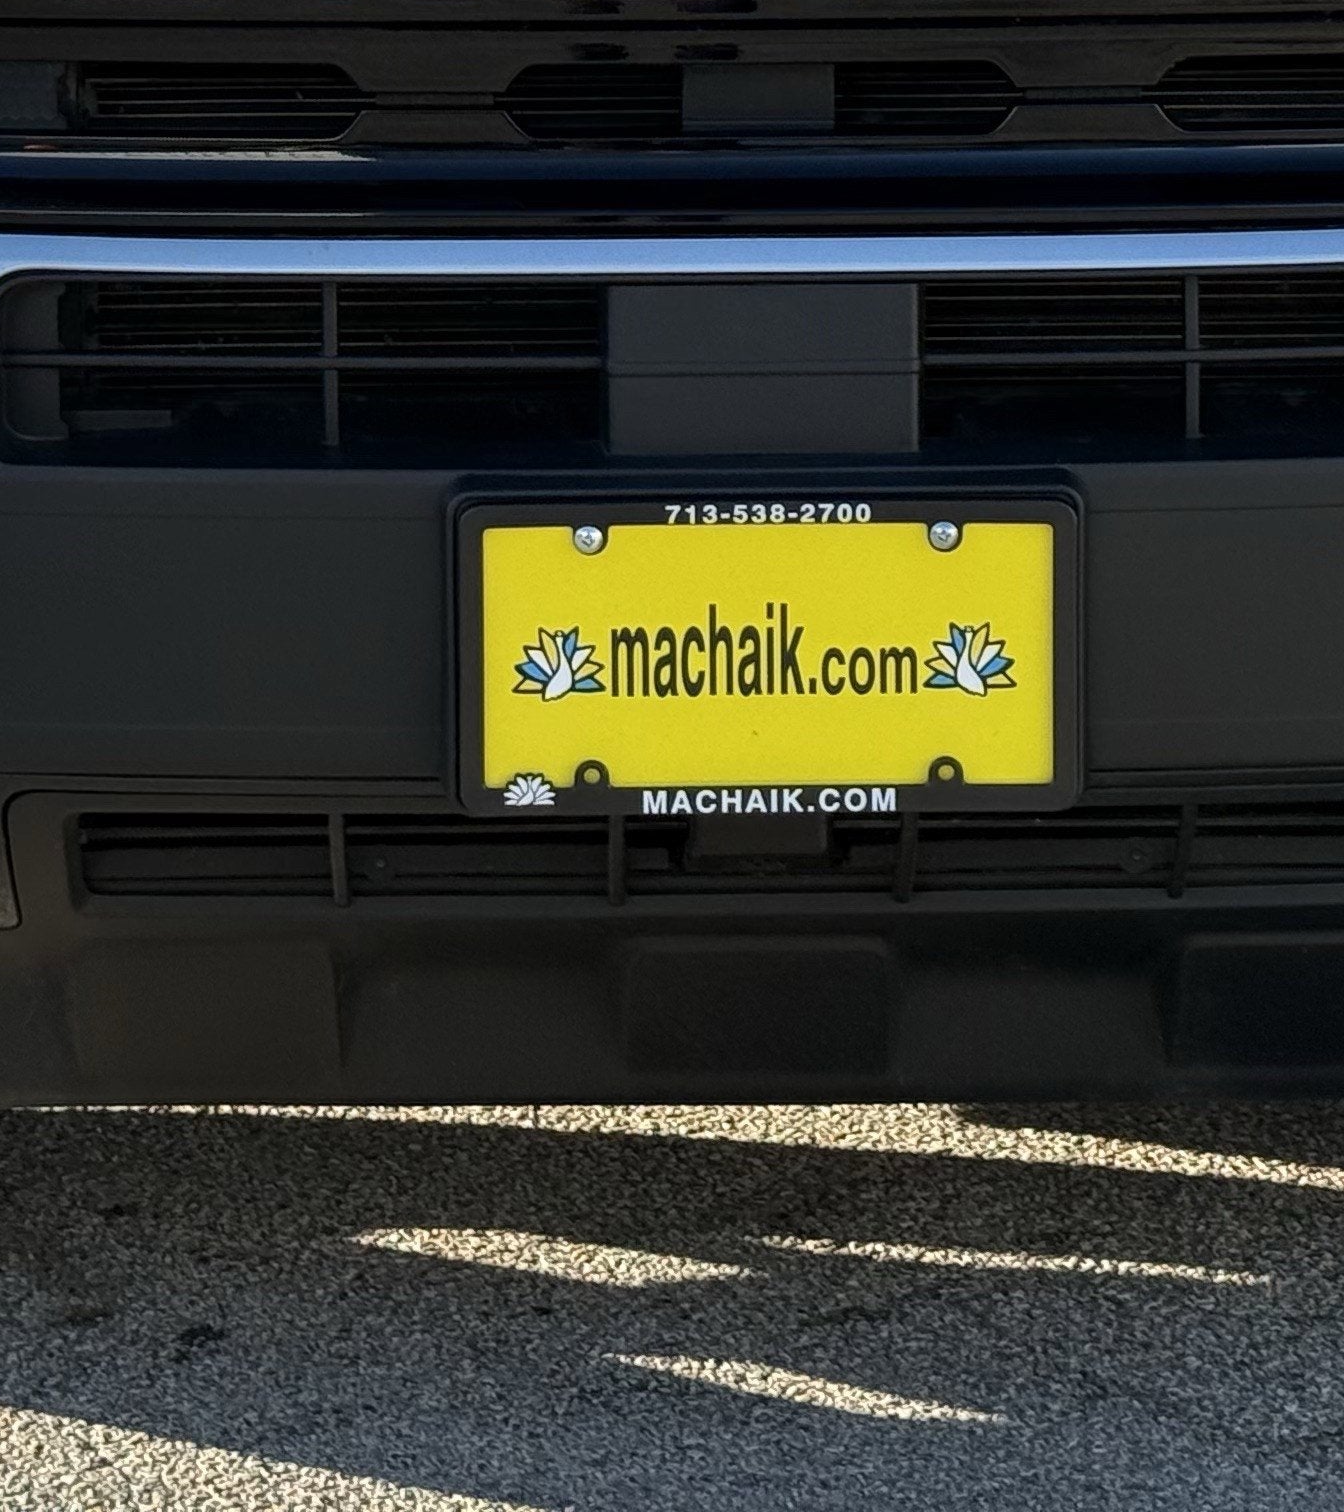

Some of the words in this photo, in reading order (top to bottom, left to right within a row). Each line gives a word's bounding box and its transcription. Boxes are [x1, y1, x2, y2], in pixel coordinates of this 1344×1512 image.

[664, 503, 873, 525] 713-538-2700
[610, 603, 920, 698] machaik.com
[642, 789, 897, 815] MACHAIK.COM
